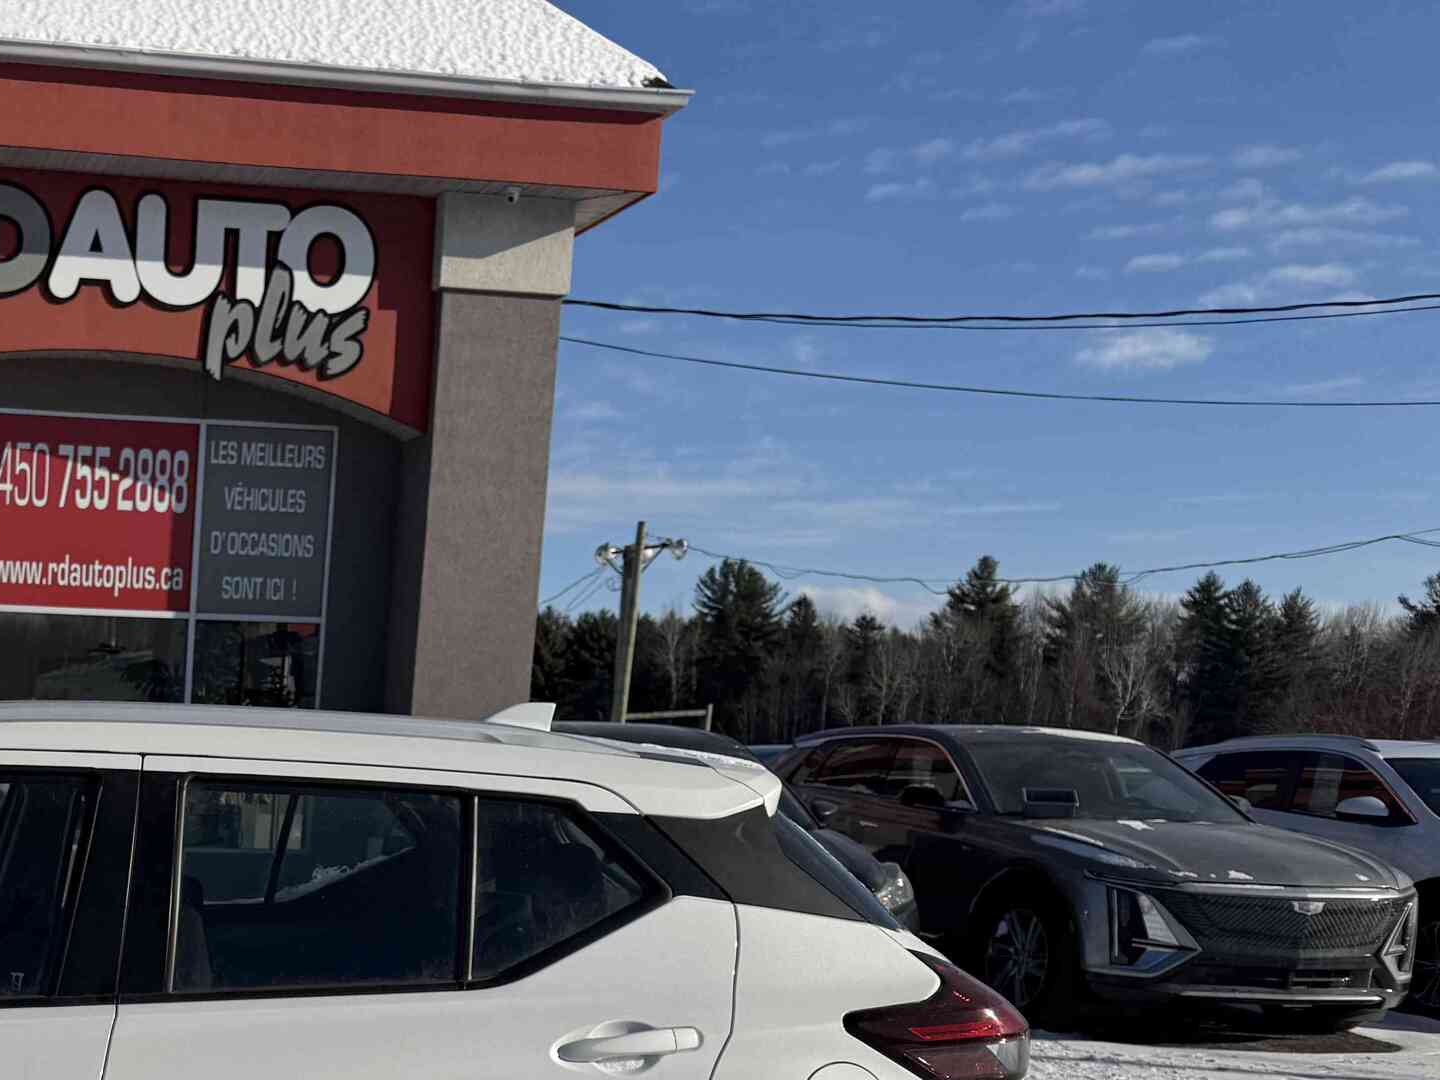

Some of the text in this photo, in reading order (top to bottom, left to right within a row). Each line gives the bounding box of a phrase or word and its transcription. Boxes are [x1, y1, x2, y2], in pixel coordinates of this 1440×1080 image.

[203, 262, 368, 380] plus
[210, 440, 325, 469] LES MEILLEURS
[58, 444, 189, 513] 755-2888
[224, 481, 306, 513] VÉHICULES
[210, 531, 315, 558] D'OCCASIONS
[221, 576, 263, 600] SONT
[266, 578, 285, 600] ICI
